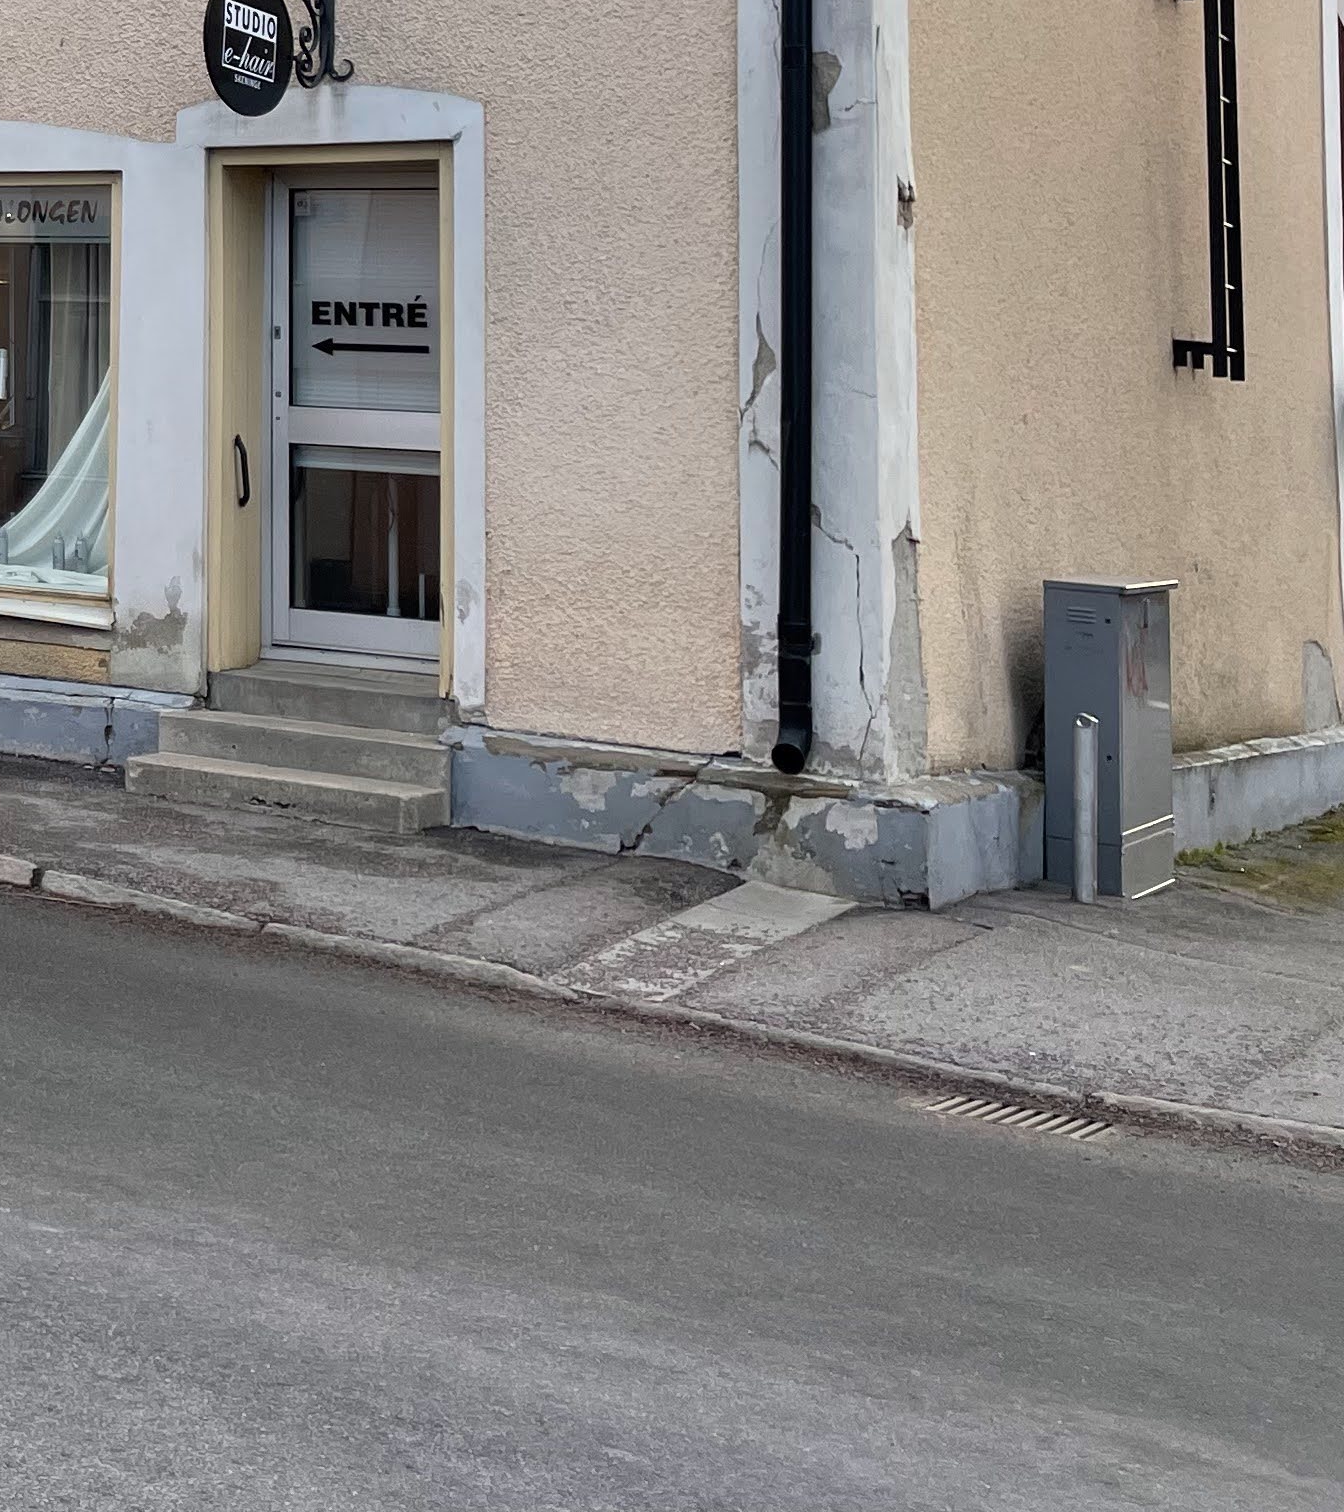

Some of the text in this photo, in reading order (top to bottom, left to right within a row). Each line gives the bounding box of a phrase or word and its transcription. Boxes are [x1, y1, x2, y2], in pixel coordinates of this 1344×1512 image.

[226, 2, 275, 39] STUDIO
[224, 36, 273, 76] e-hair
[312, 295, 428, 328] ENTRÉ
